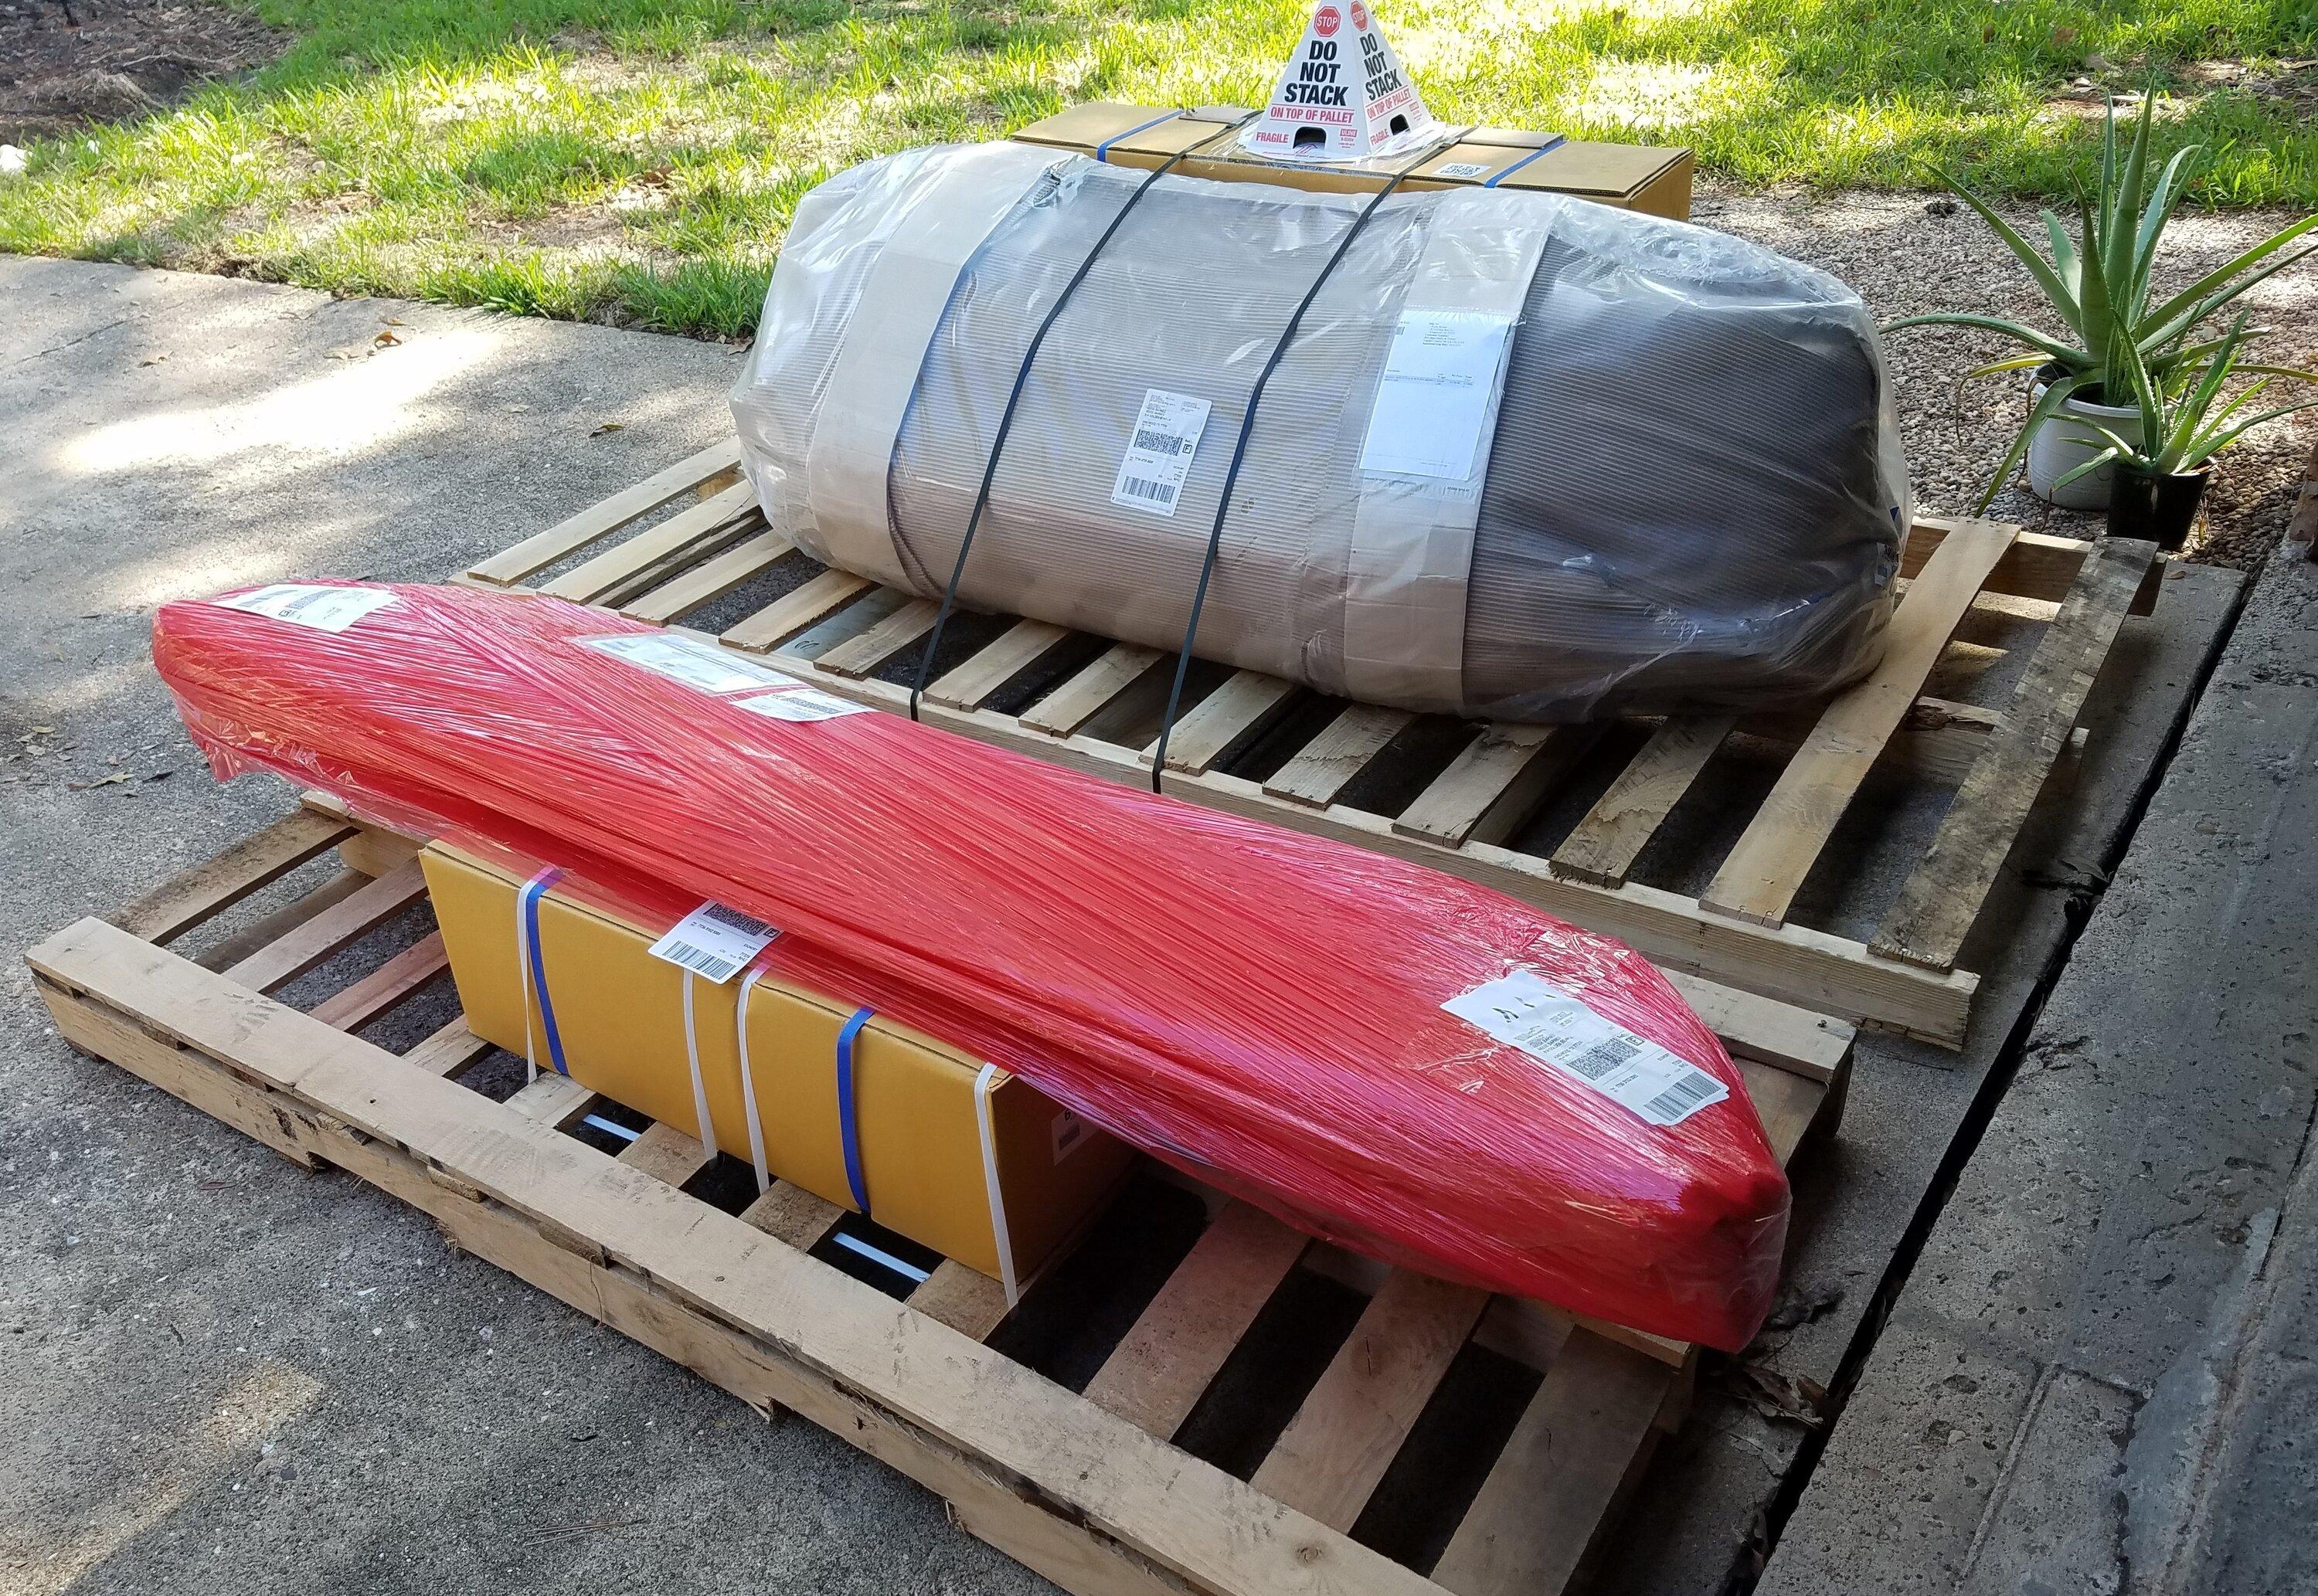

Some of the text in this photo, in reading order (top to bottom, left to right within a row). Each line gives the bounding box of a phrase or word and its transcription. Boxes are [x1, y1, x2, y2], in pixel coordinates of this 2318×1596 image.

[1317, 15, 1338, 28] STOP
[1309, 40, 1337, 61] DO
[1359, 32, 1378, 56] DO
[1300, 62, 1341, 83] NOT
[1364, 51, 1387, 78] NOT
[1284, 83, 1349, 107] STACK
[1365, 68, 1402, 101] STACK
[1367, 88, 1411, 119] ON TOP OF PALLET
[1270, 107, 1354, 124] ON TOP OF PALLET
[1256, 131, 1289, 144] FRAGILE
[1370, 128, 1388, 145] FRAGILE
